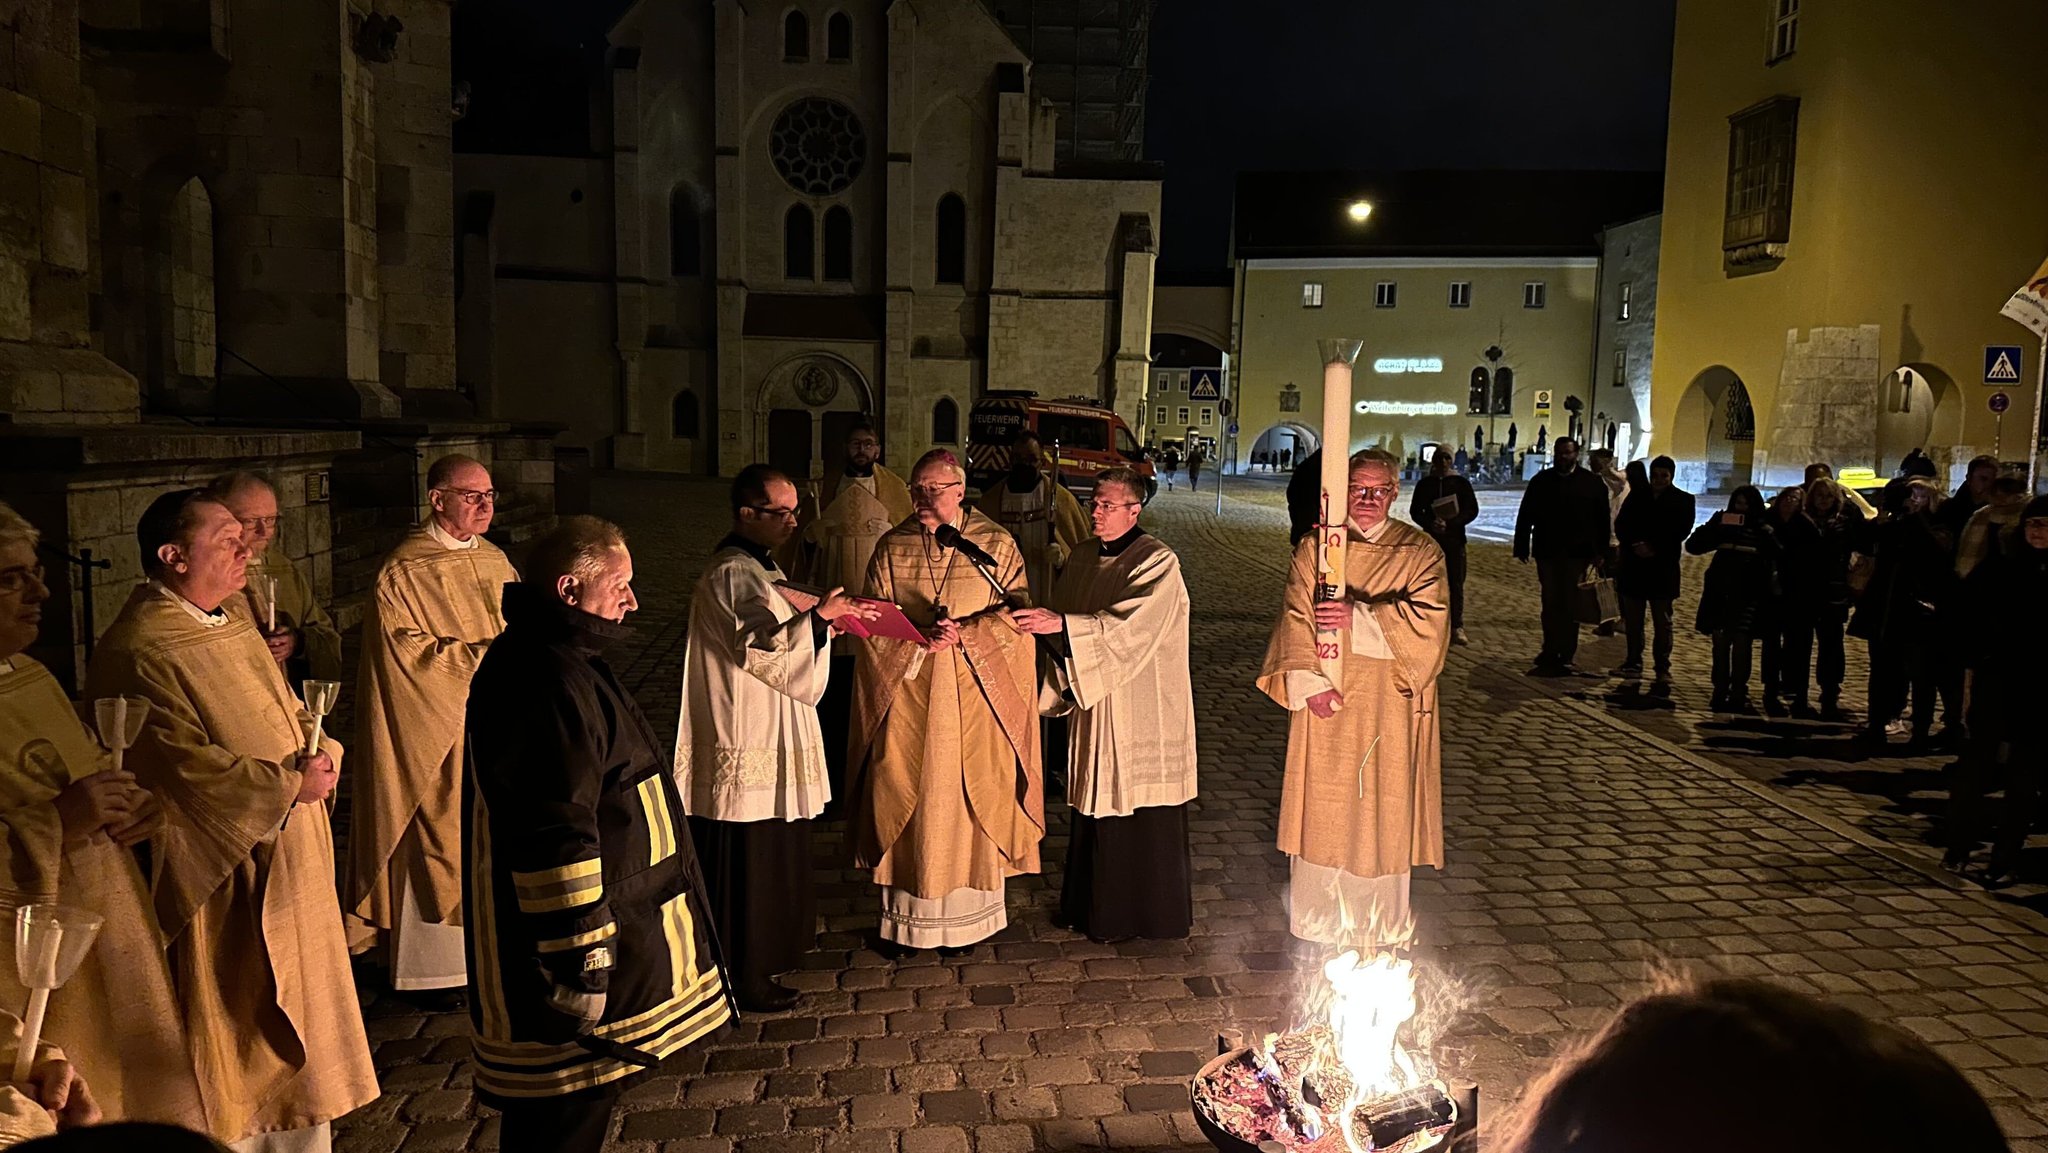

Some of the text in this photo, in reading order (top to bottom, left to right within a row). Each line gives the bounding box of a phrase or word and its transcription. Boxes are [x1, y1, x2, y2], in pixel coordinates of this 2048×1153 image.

[974, 414, 1020, 425] FEUERWEHR
[994, 426, 1007, 435] 112
[1086, 461, 1097, 470] 112
